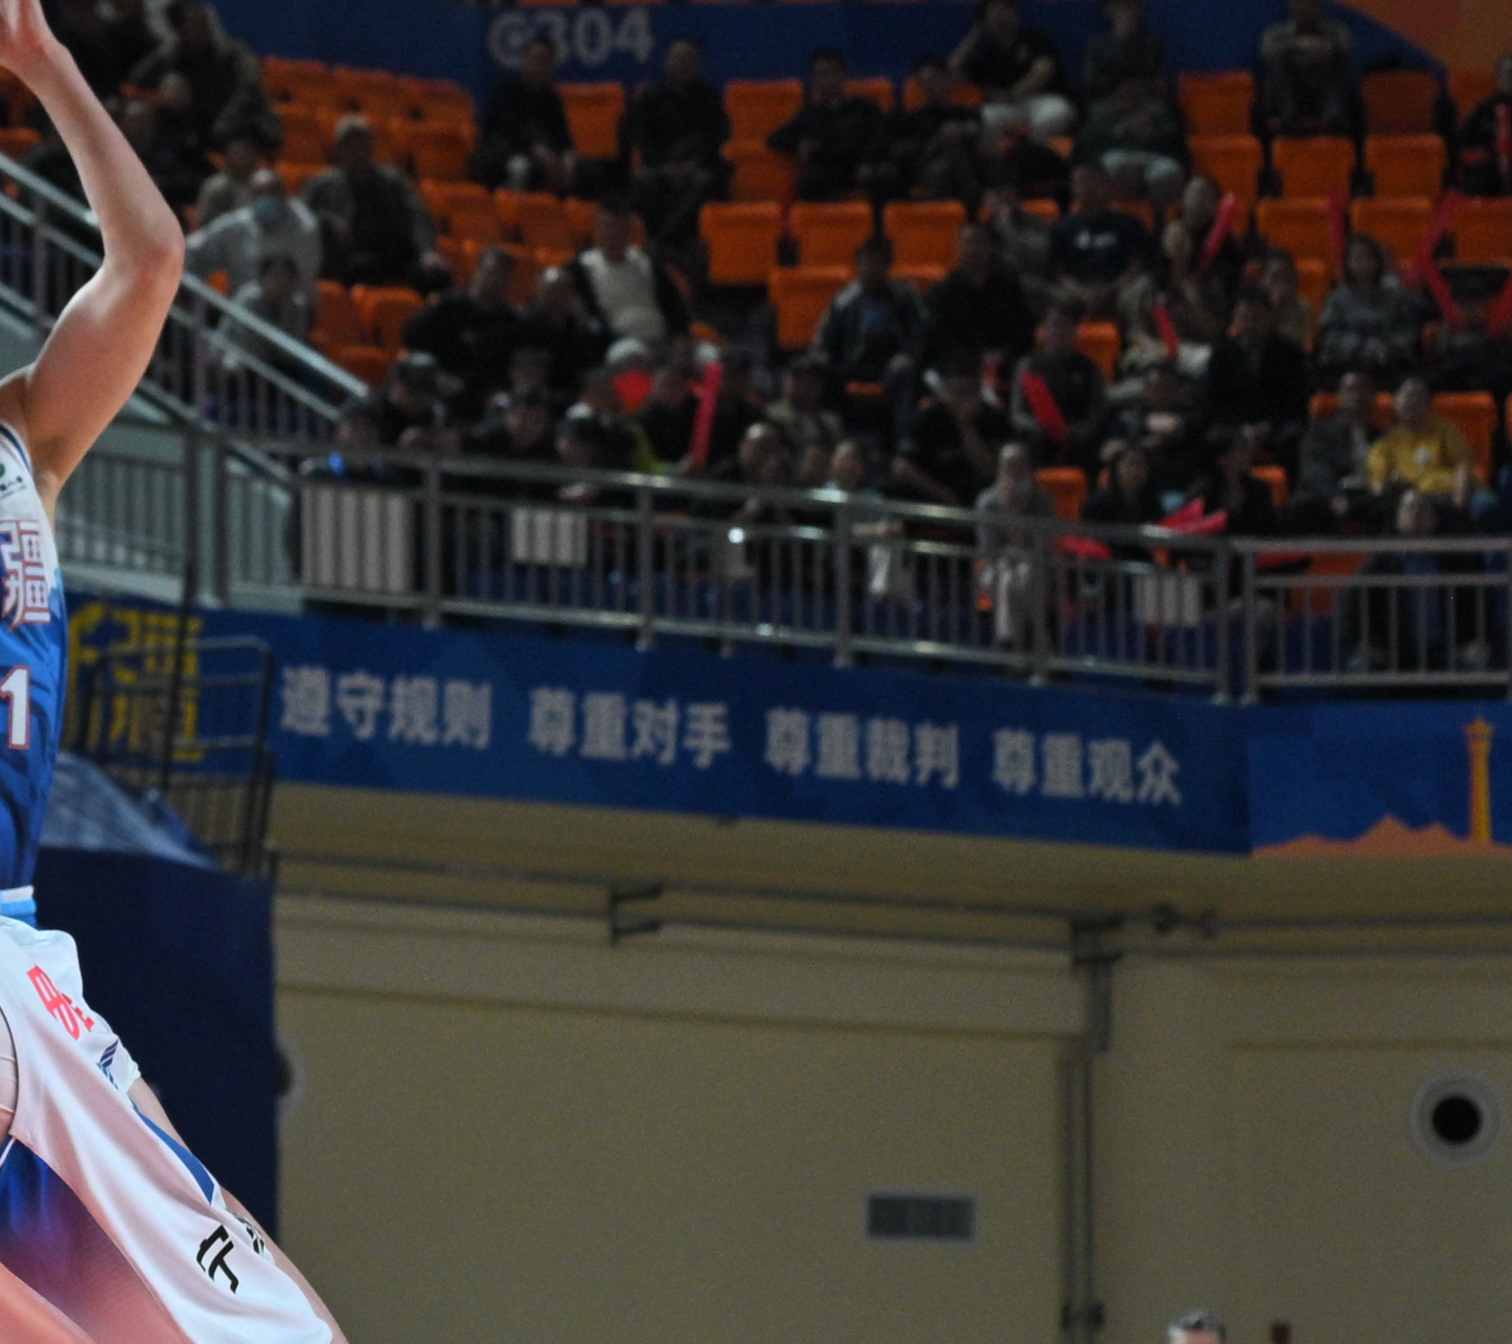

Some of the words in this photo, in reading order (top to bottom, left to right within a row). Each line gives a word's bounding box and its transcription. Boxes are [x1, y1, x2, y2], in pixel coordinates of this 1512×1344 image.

[280, 666, 494, 753] 遵守规则
[527, 685, 733, 771] 尊重对手
[764, 707, 961, 791] 尊重裁判
[992, 727, 1182, 808] 尊重观众
